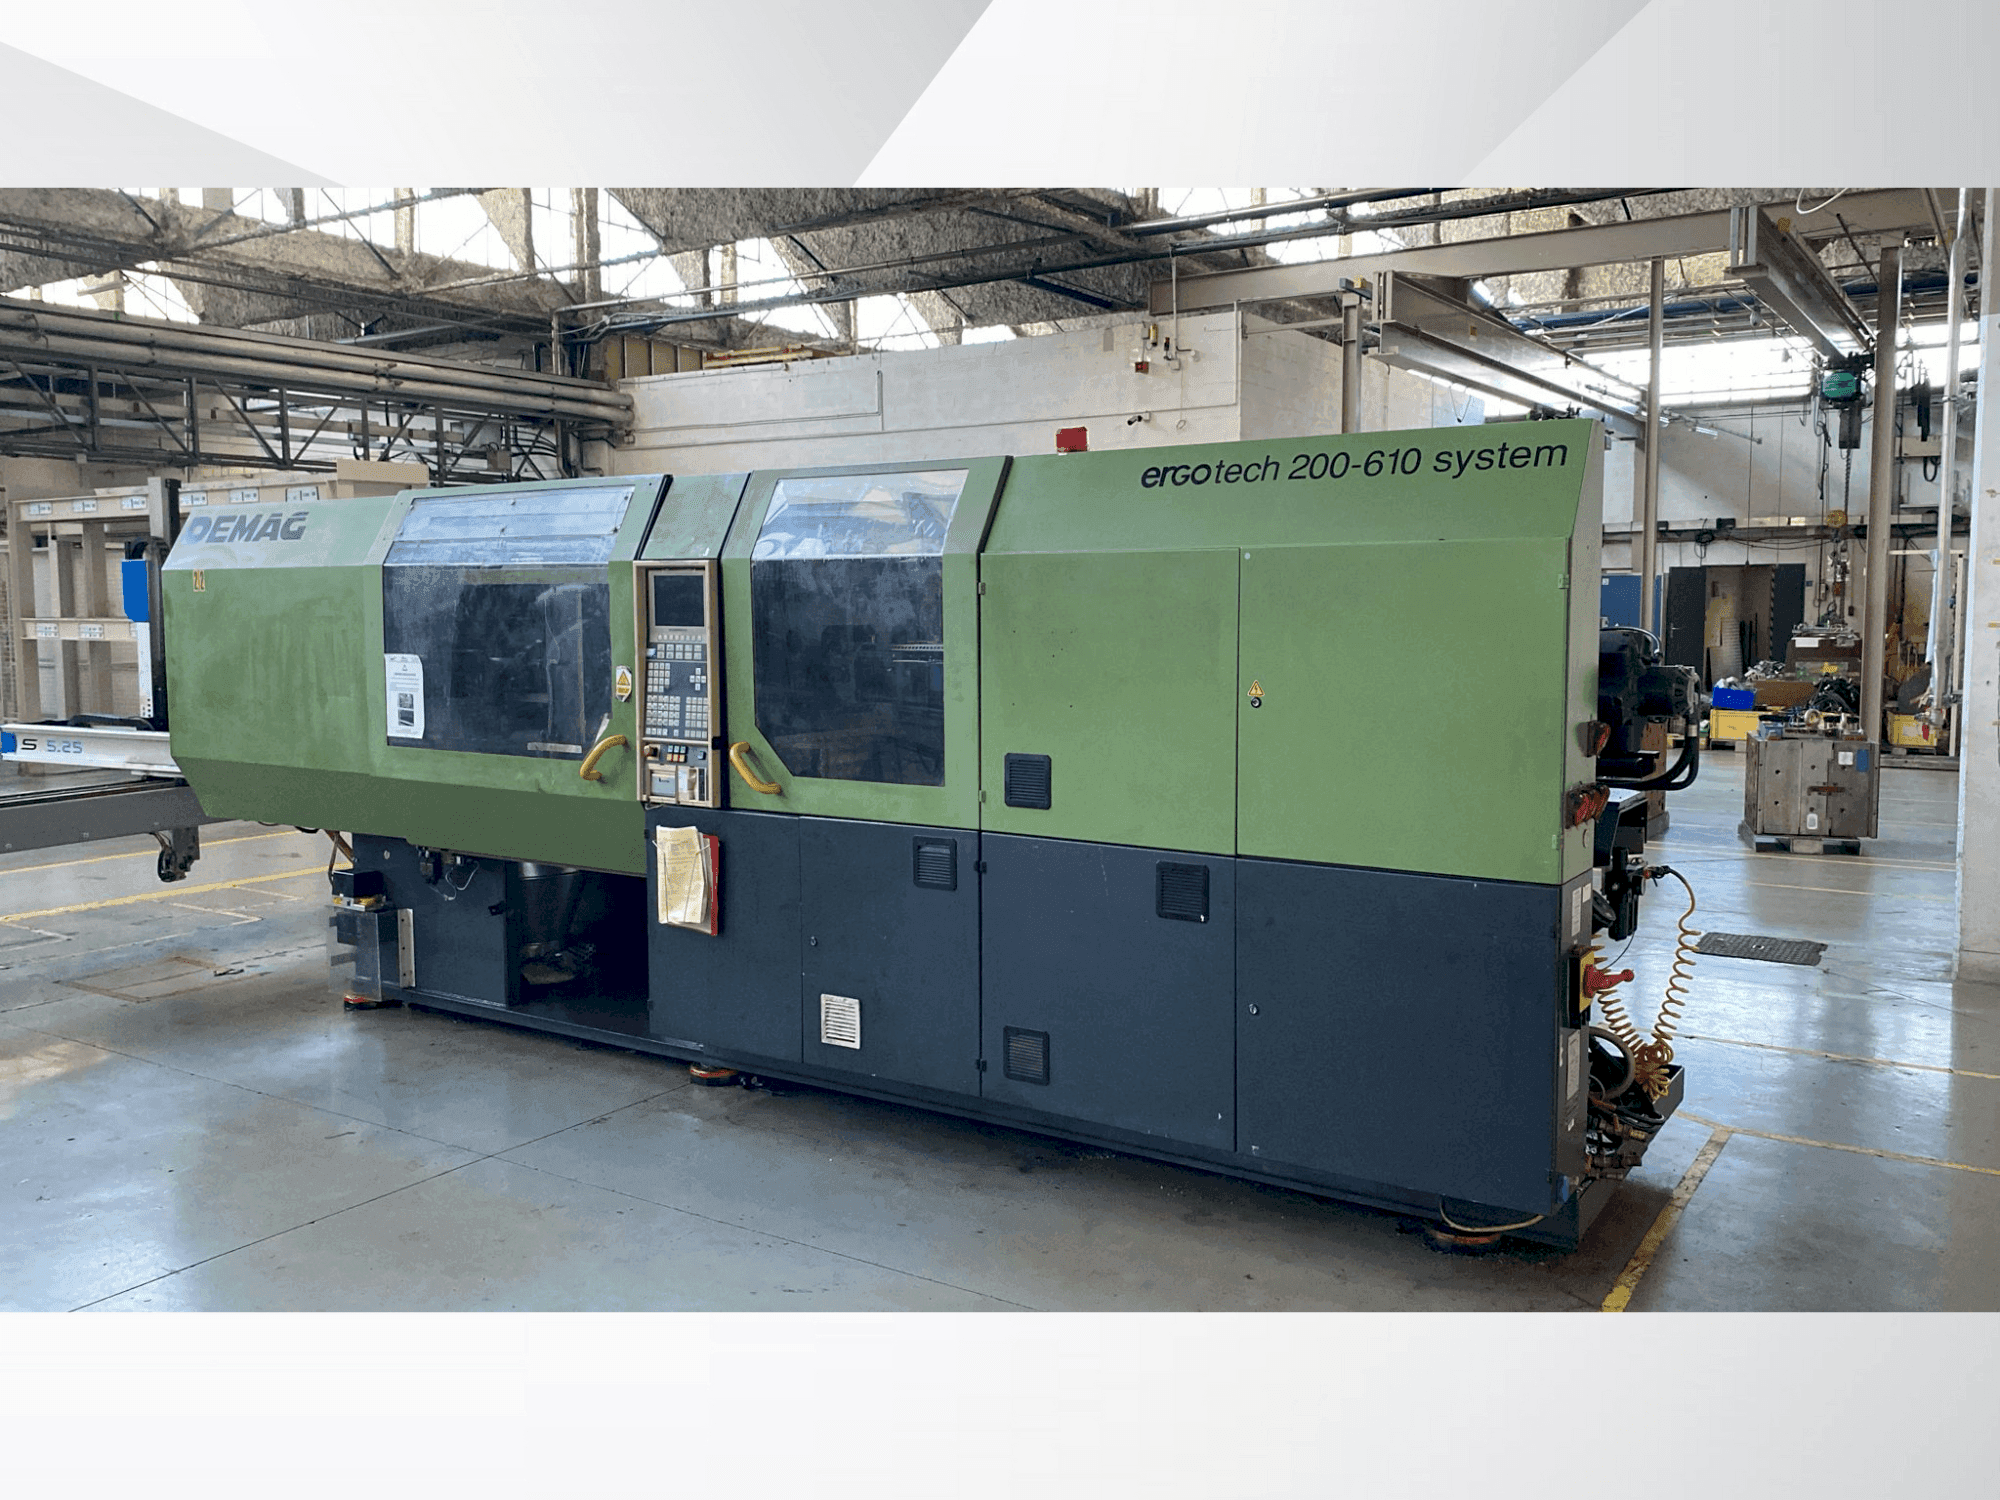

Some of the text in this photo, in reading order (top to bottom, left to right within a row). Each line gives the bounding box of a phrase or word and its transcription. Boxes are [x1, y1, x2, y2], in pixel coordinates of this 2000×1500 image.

[1288, 447, 1422, 480] 200-610
[1433, 442, 1568, 479] system
[182, 512, 309, 544] DEMAG
[21, 738, 38, 751] S
